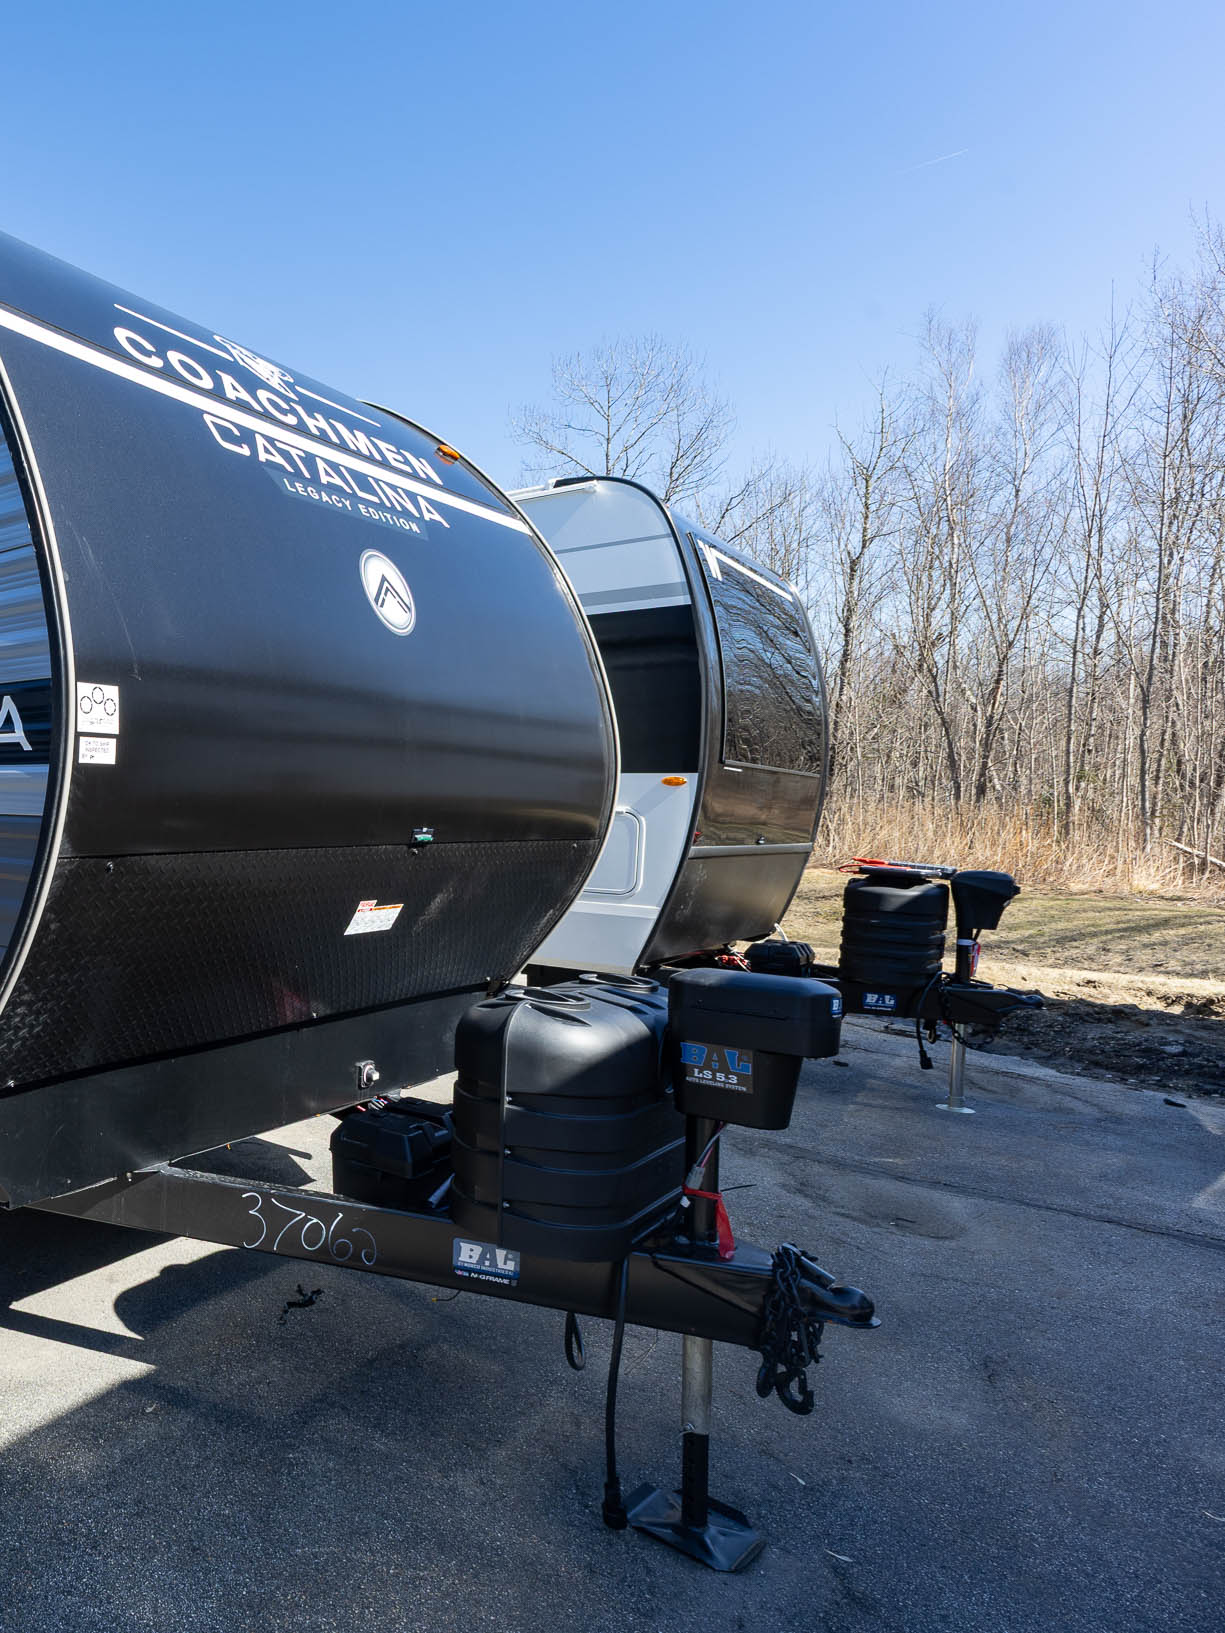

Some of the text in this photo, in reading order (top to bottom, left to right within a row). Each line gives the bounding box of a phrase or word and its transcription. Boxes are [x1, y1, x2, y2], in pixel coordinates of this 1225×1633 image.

[113, 327, 444, 486] COACHMEN
[203, 413, 450, 528] CATALINA
[284, 478, 421, 534] LEGACY EDITION
[679, 1041, 752, 1075] BAL
[693, 1068, 738, 1085] LS 5.3
[458, 1242, 515, 1271] BAL
